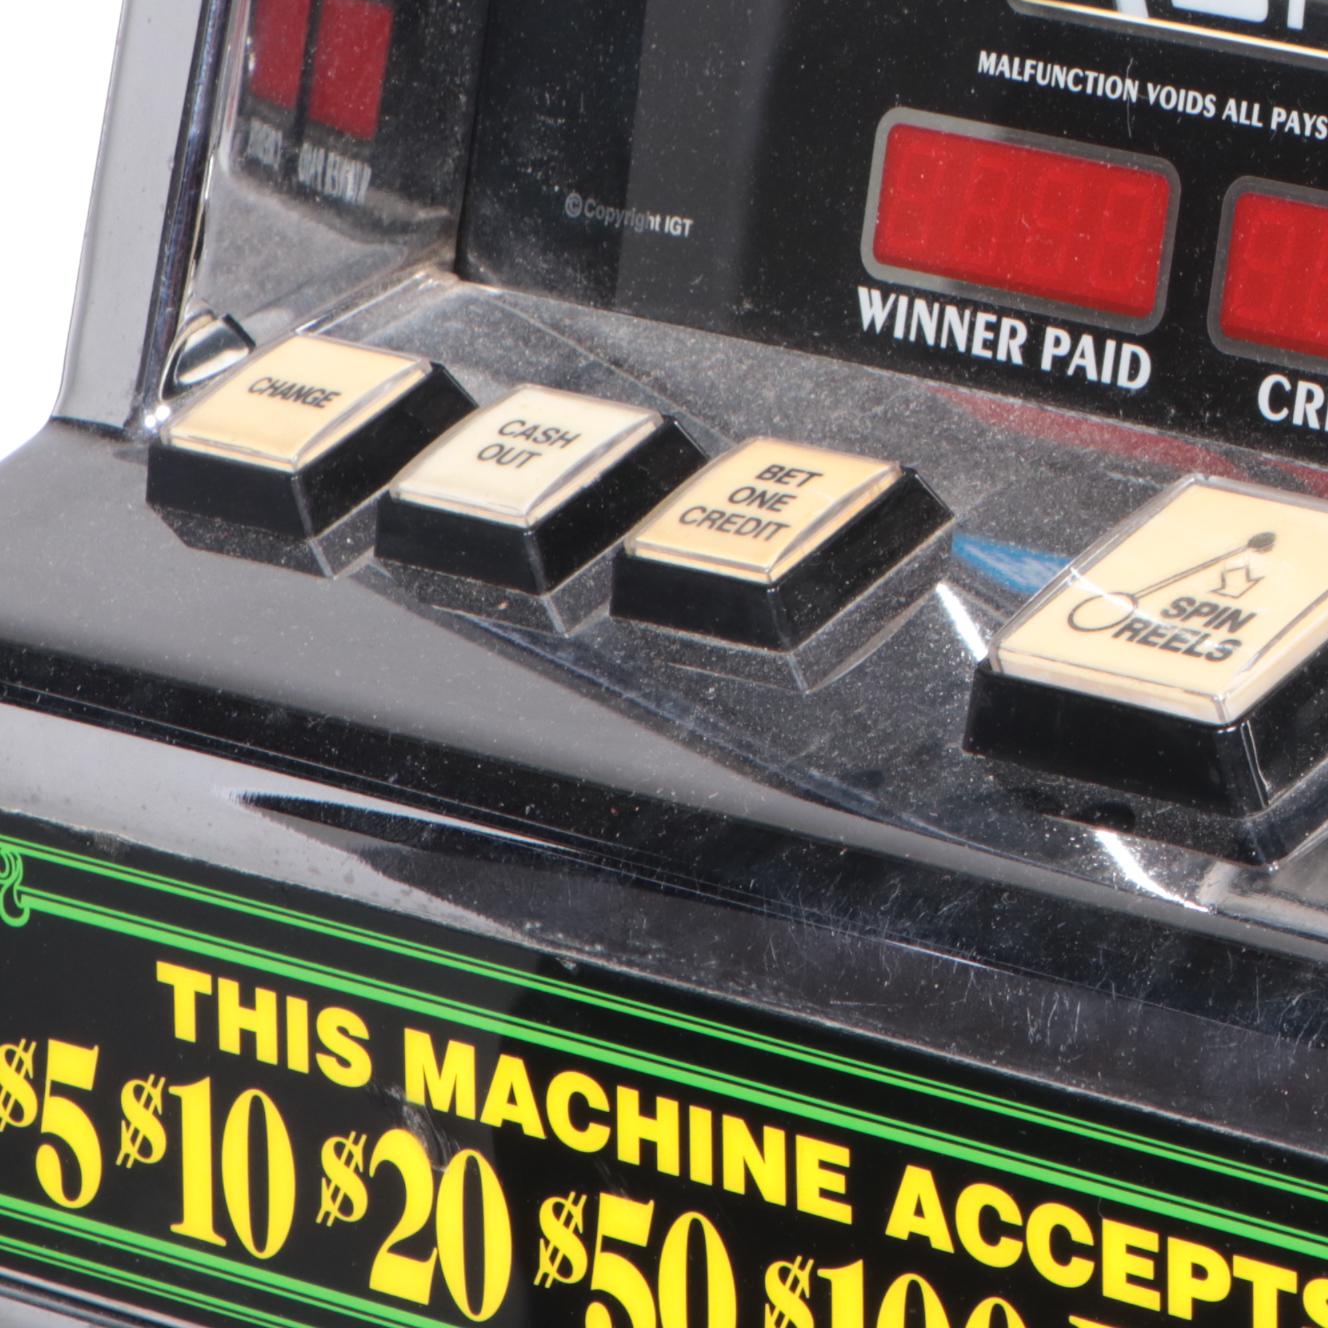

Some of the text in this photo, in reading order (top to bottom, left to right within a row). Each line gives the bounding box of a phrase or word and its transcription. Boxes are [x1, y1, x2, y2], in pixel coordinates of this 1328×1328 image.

[977, 50, 1138, 102] MALFUNCTION
[1147, 83, 1217, 118] VOIDS
[1222, 98, 1263, 129] ALL
[1271, 106, 1328, 140] PAYS
[664, 215, 693, 237] IGT
[856, 286, 1152, 391] WINNER PAID
[247, 375, 340, 410] CHANGE
[497, 419, 581, 450] CASH
[477, 442, 541, 471] OUT
[756, 463, 823, 490] BET
[728, 484, 797, 514] ONE
[678, 504, 791, 543] CREDIT
[1161, 596, 1257, 634] SPIN
[1117, 618, 1242, 662] REELS
[156, 961, 371, 1088] THIS
[404, 1028, 852, 1224] MACHINE
[0, 1039, 102, 1208] $5
[116, 1074, 296, 1260] $10
[315, 1128, 513, 1323] $20
[532, 1191, 737, 1328] $50
